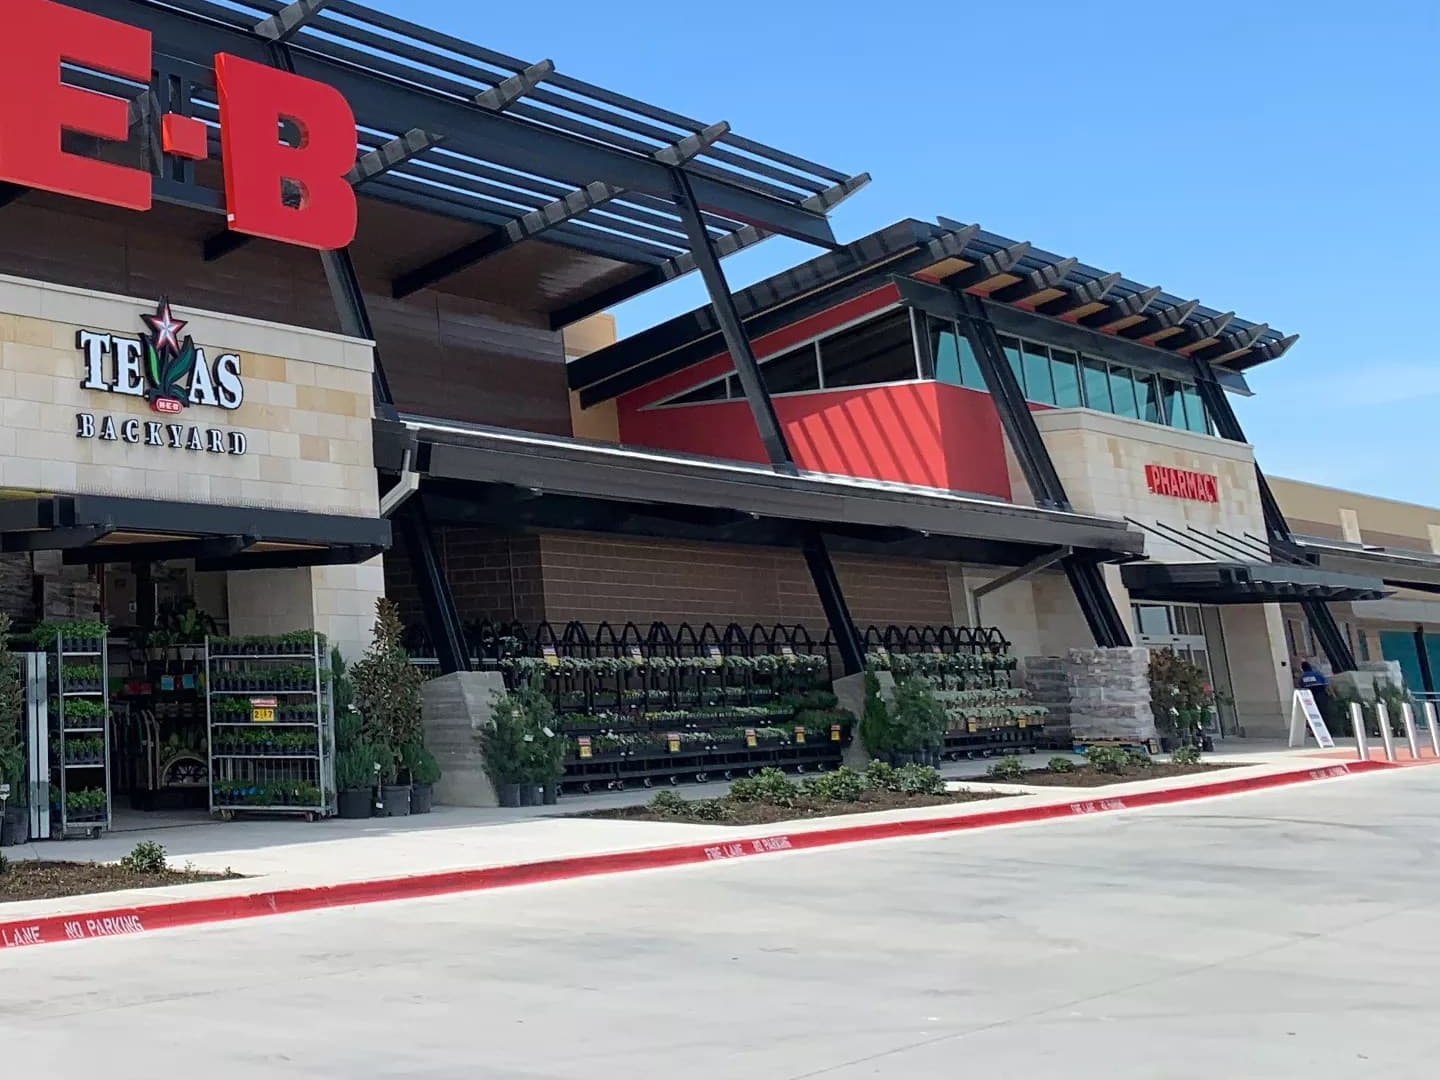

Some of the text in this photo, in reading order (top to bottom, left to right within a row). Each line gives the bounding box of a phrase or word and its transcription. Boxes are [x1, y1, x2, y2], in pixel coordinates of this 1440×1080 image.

[76, 413, 247, 455] BACKYARD
[2, 926, 45, 948] LANE
[64, 921, 84, 938] NO
[86, 915, 144, 937] PARKING
